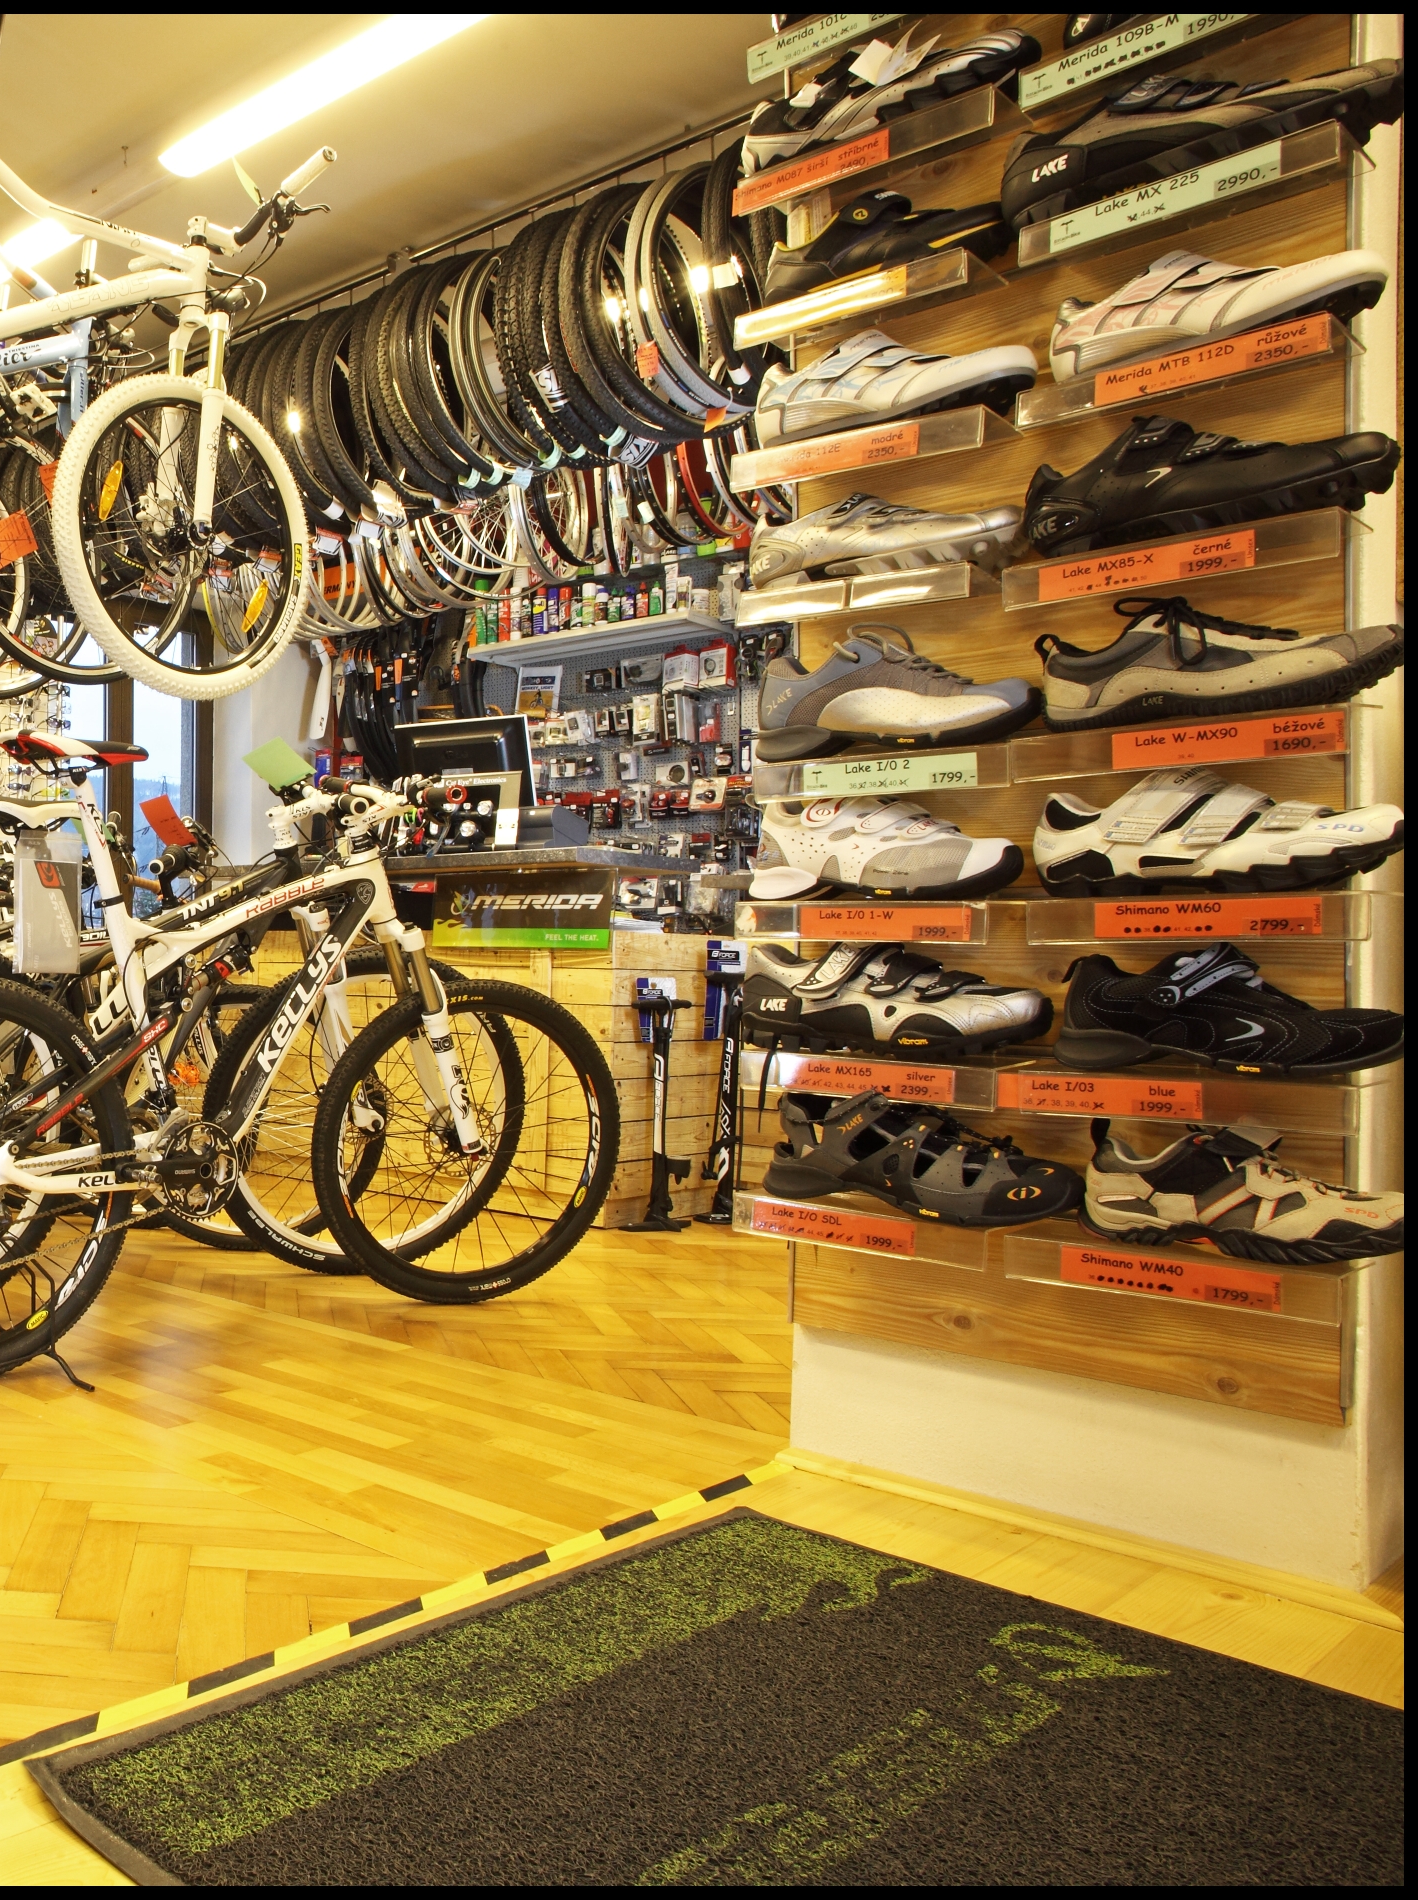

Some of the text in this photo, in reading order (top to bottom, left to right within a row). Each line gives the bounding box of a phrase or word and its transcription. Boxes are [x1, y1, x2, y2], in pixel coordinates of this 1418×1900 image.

[776, 26, 814, 50] Merida
[1058, 44, 1109, 72] Merida
[838, 139, 879, 161] stříbrné
[776, 167, 803, 185] M087
[1032, 154, 1069, 183] LAKE
[1095, 199, 1130, 217] Lake
[1136, 184, 1162, 203] MX
[1169, 171, 1200, 190] 225
[1256, 324, 1308, 347] růžové
[1106, 345, 1235, 385] Merida MTB 112D
[871, 430, 904, 446] modré
[815, 443, 841, 457] 112E
[1192, 538, 1232, 556] černé
[293, 542, 303, 581] GEAX
[1062, 553, 1154, 579] Lake MX85-X
[273, 594, 299, 644] SAGUARO
[1142, 695, 1164, 706] LAKE
[1272, 717, 1325, 734] béžové
[1135, 726, 1238, 748] Lake W-MX90
[844, 763, 871, 775] Lake
[902, 759, 910, 770] 2
[473, 777, 507, 785] Electronics
[1314, 823, 1365, 834] SPD
[181, 893, 220, 921] TNT
[470, 893, 604, 911] MERIDA
[1115, 902, 1222, 916] Shimano WM60
[819, 909, 843, 921] Lake
[869, 910, 894, 921] 1-W
[545, 933, 563, 942] FEEL
[564, 934, 578, 942] THE
[719, 951, 737, 960] FORCE
[760, 998, 788, 1012] LAKE
[897, 1037, 929, 1046] vibram
[723, 1053, 731, 1093] FORCE
[807, 1063, 872, 1078] Lake MX165
[906, 1072, 936, 1082] silver
[1031, 1080, 1060, 1092] Lake
[1148, 1085, 1176, 1098] blue
[845, 1113, 863, 1131] LAKE
[771, 1206, 795, 1219] Lake
[821, 1213, 843, 1226] SDL
[1344, 1206, 1380, 1219] SPD
[247, 1209, 326, 1262] SCHWALBE
[1081, 1252, 1184, 1277] Shimano WM40
